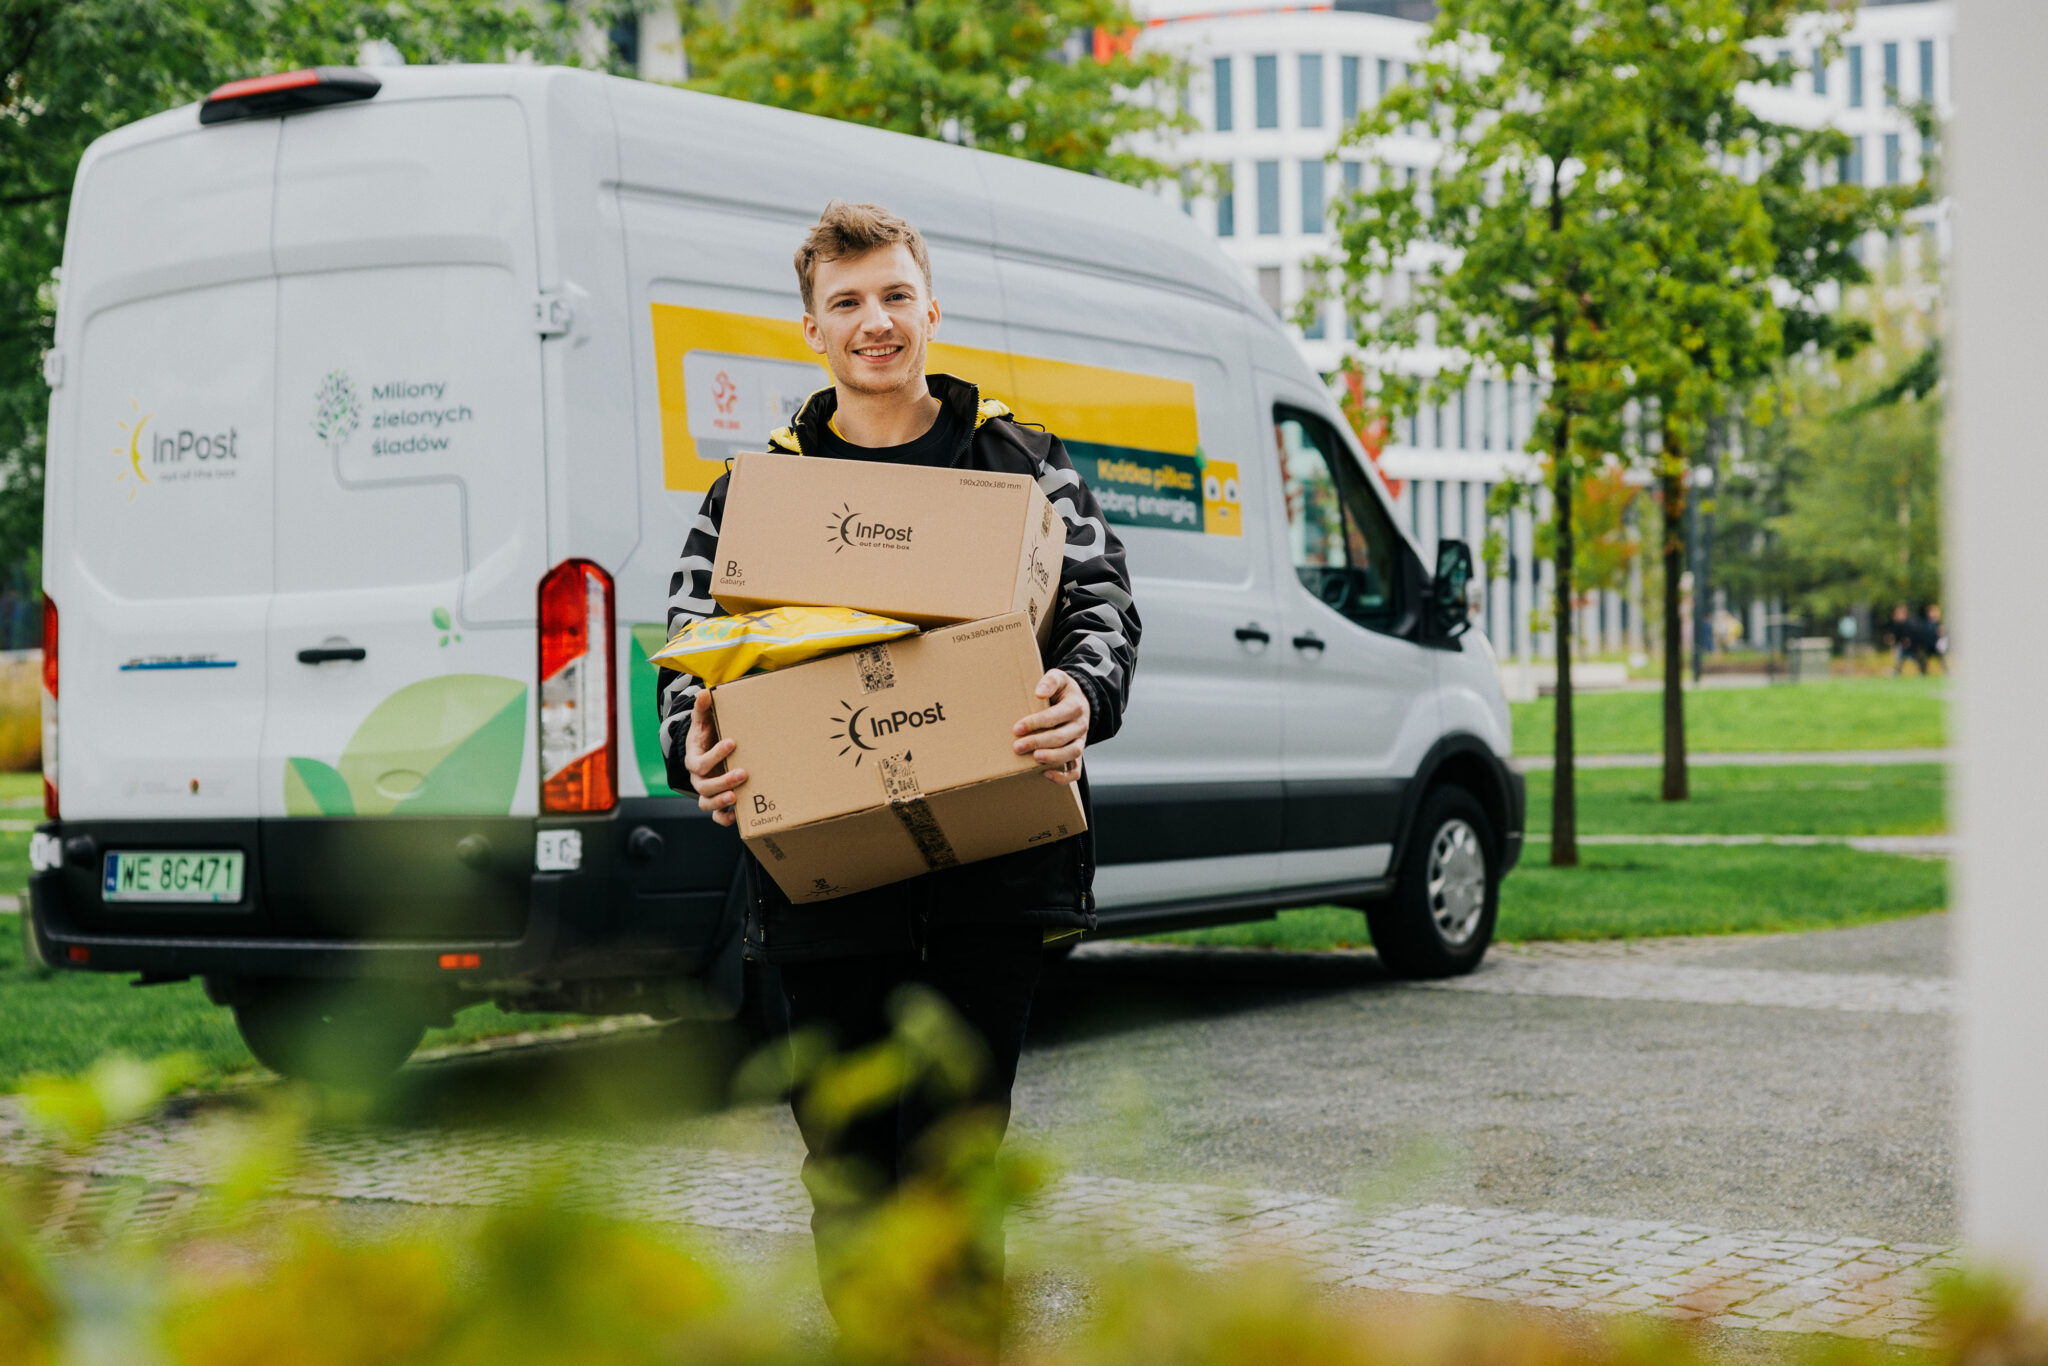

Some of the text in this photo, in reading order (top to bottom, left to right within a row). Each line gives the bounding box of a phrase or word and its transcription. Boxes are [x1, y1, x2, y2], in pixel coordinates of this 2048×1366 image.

[372, 381, 447, 400] Miliony
[372, 404, 472, 429] zielonych
[153, 427, 237, 464] InPost
[959, 478, 1006, 489] 190x200x380
[856, 522, 913, 543] InPost
[719, 577, 746, 587] Gabaryt
[951, 621, 1022, 644] 190x380x400 mm
[870, 702, 946, 738] InPost
[753, 794, 777, 814] B6
[750, 814, 783, 827] Gabaryt
[122, 857, 232, 890] WE 8G471
